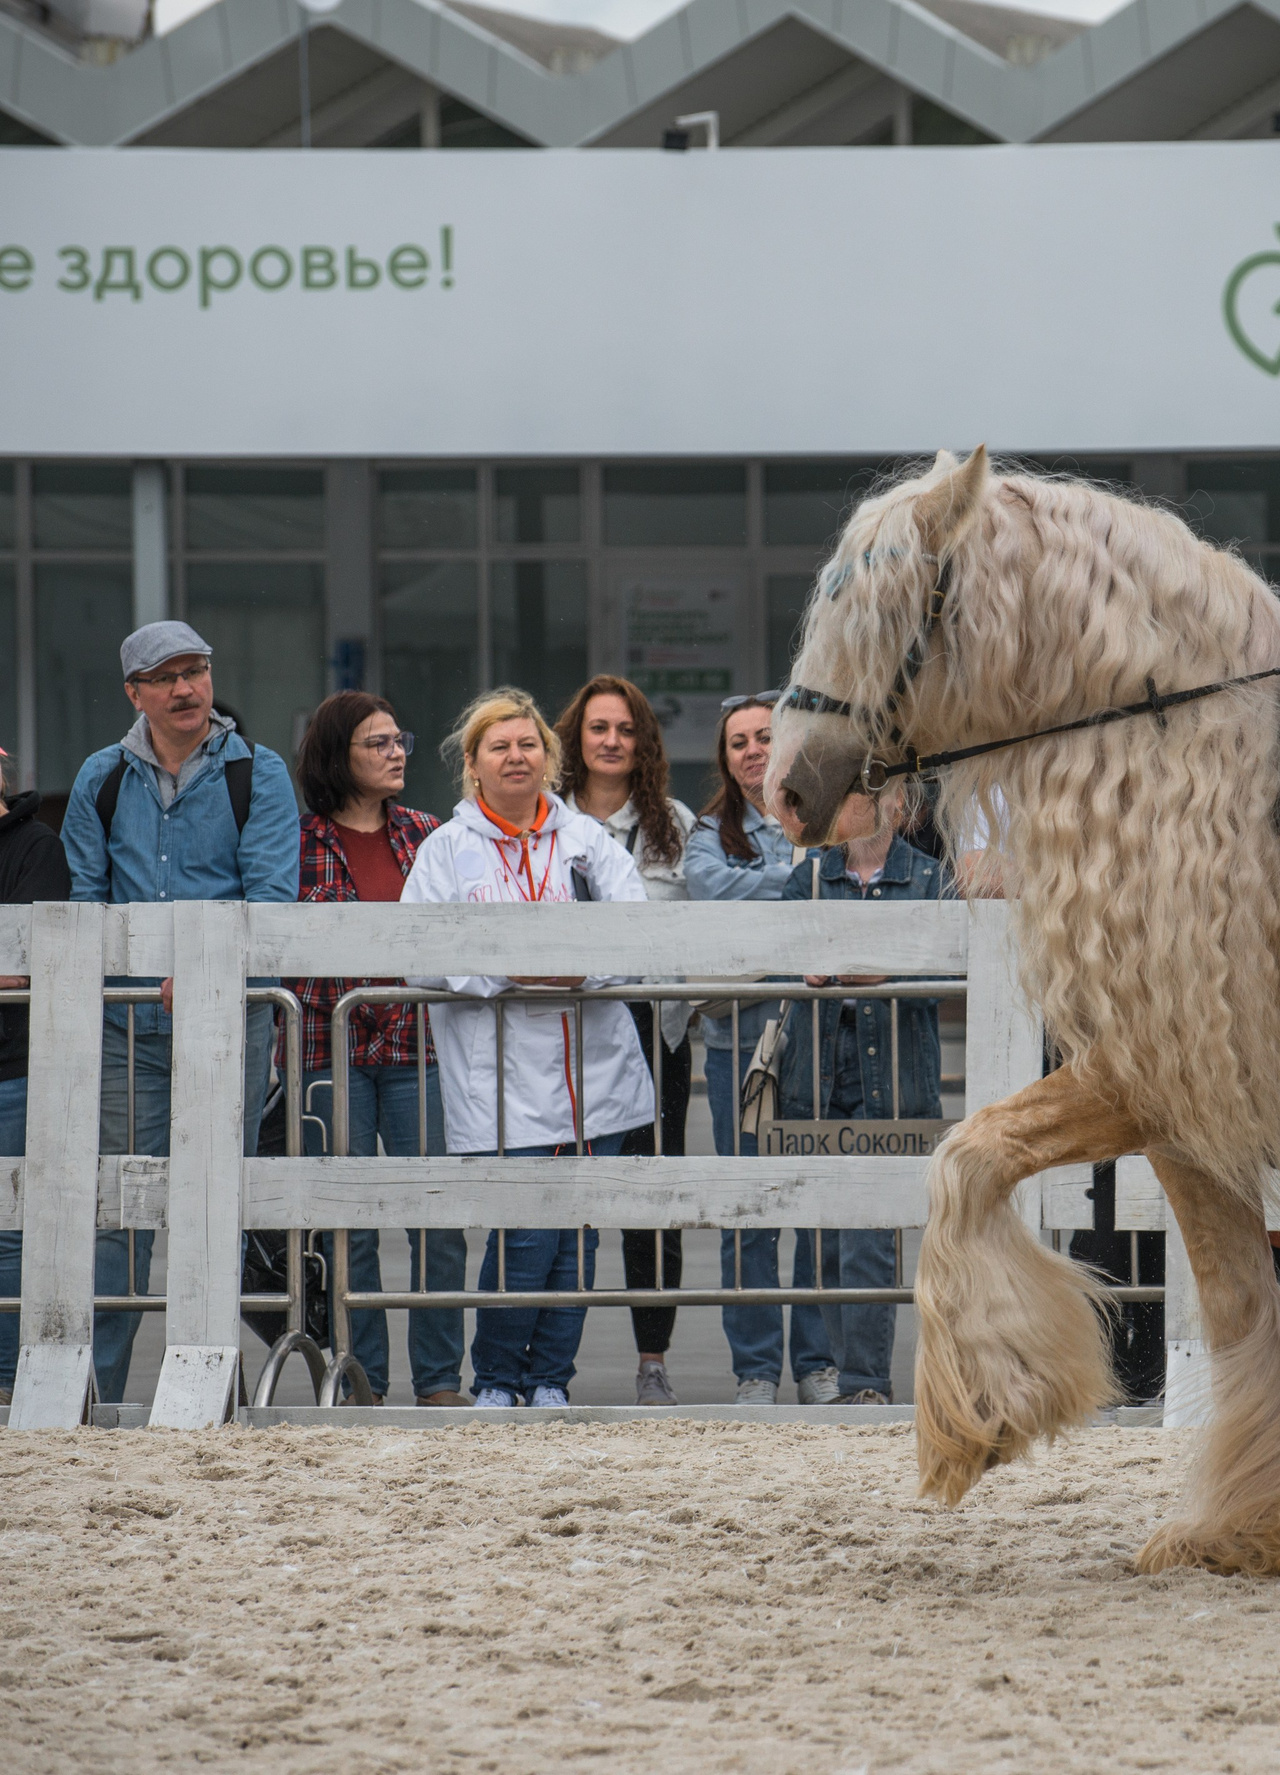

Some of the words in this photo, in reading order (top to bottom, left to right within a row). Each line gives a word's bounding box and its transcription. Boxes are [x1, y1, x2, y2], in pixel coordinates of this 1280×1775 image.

[56, 224, 455, 310] здоровье!
[767, 1127, 831, 1156] Парк
[838, 1126, 935, 1155] Соколь
